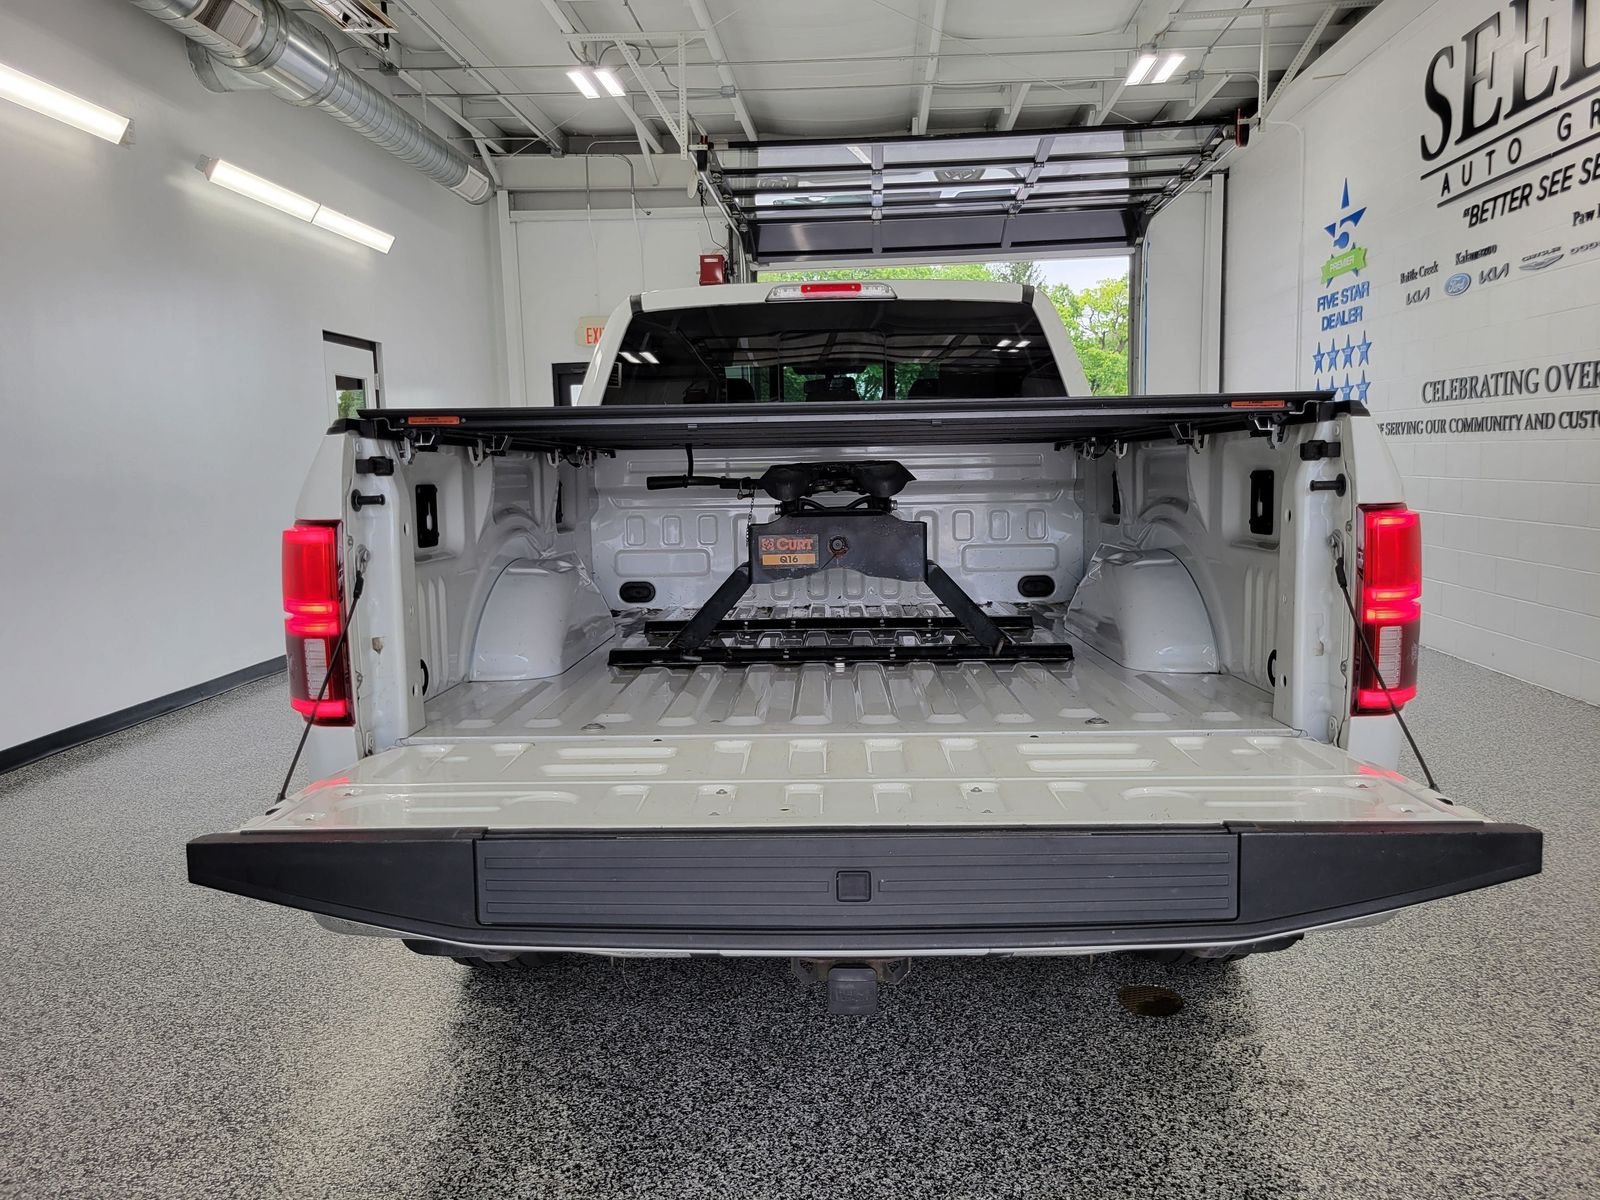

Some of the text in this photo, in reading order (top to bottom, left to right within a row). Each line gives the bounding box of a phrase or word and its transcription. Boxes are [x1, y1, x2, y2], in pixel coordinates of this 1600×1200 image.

[1441, 138, 1522, 197] AUTO
[1536, 163, 1576, 202] SEE
[1572, 210, 1595, 227] Paw
[1478, 262, 1510, 285] KIA
[1317, 281, 1370, 312] FIVE STAR
[1321, 305, 1363, 331] DEALER
[586, 327, 605, 345] EXI
[1421, 367, 1540, 404] CELEBRATING
[1385, 420, 1424, 436] SERVING
[1425, 419, 1447, 434] OUR
[1448, 414, 1524, 433] COMMUNITY
[1524, 412, 1556, 430] AND
[1558, 410, 1600, 429] CUST
[780, 555, 799, 564] Q16
